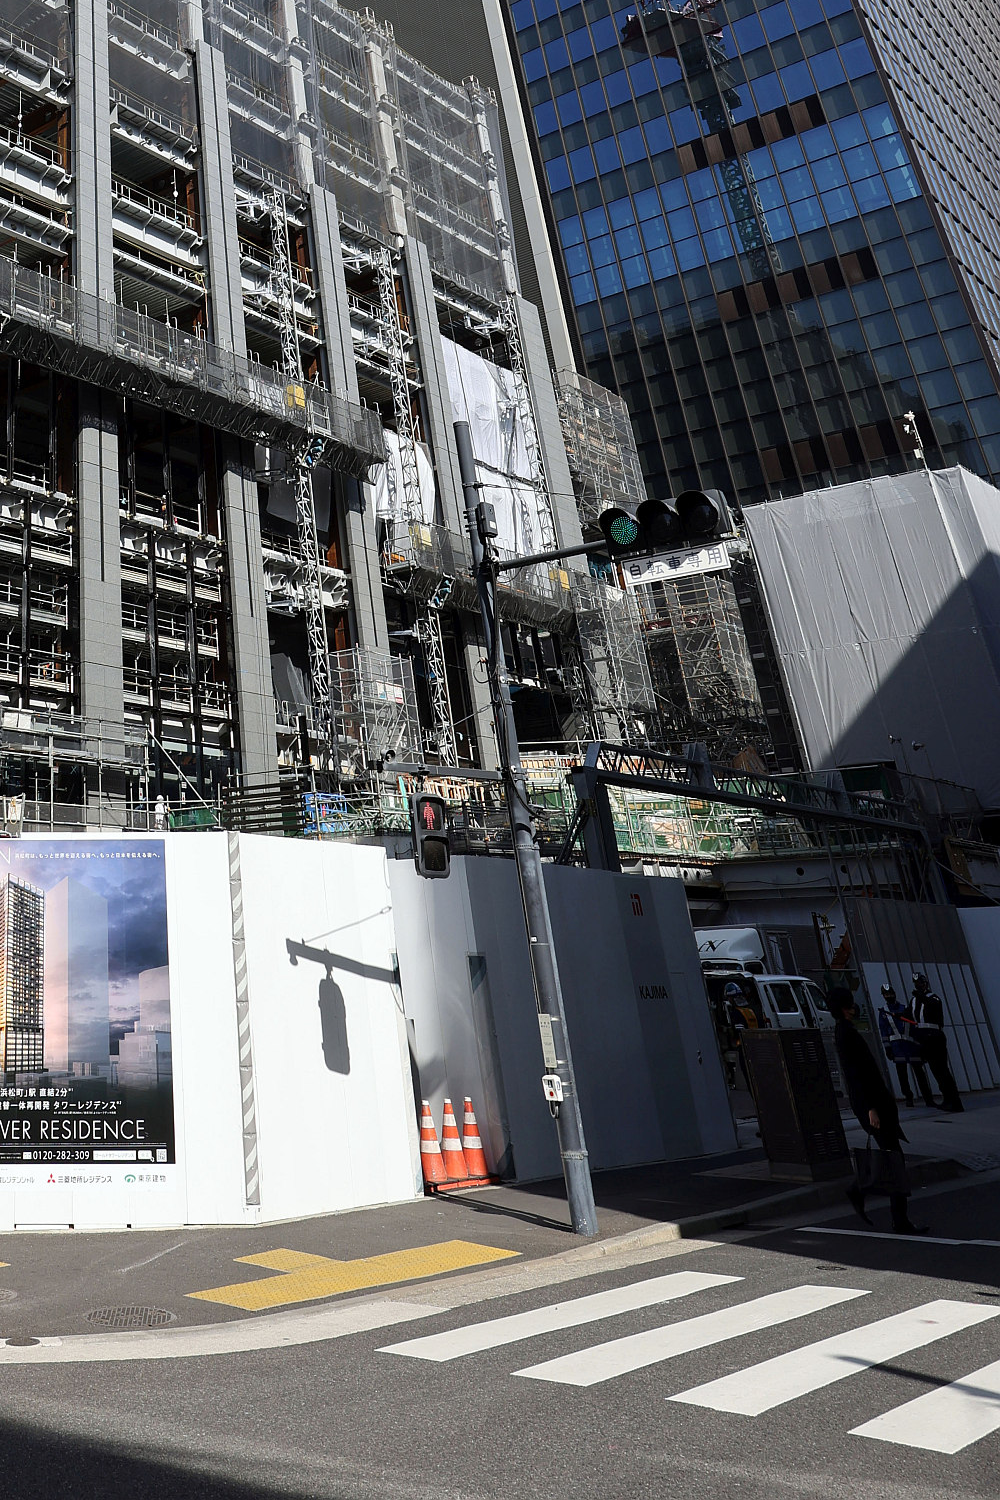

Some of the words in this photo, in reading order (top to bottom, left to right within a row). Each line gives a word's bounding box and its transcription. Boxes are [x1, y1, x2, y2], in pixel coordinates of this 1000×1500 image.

[630, 547, 722, 579] 自転車専用
[639, 986, 668, 999] KAJIMA
[40, 1119, 145, 1140] RESIDENCE
[33, 1150, 90, 1160] 0120-282-309
